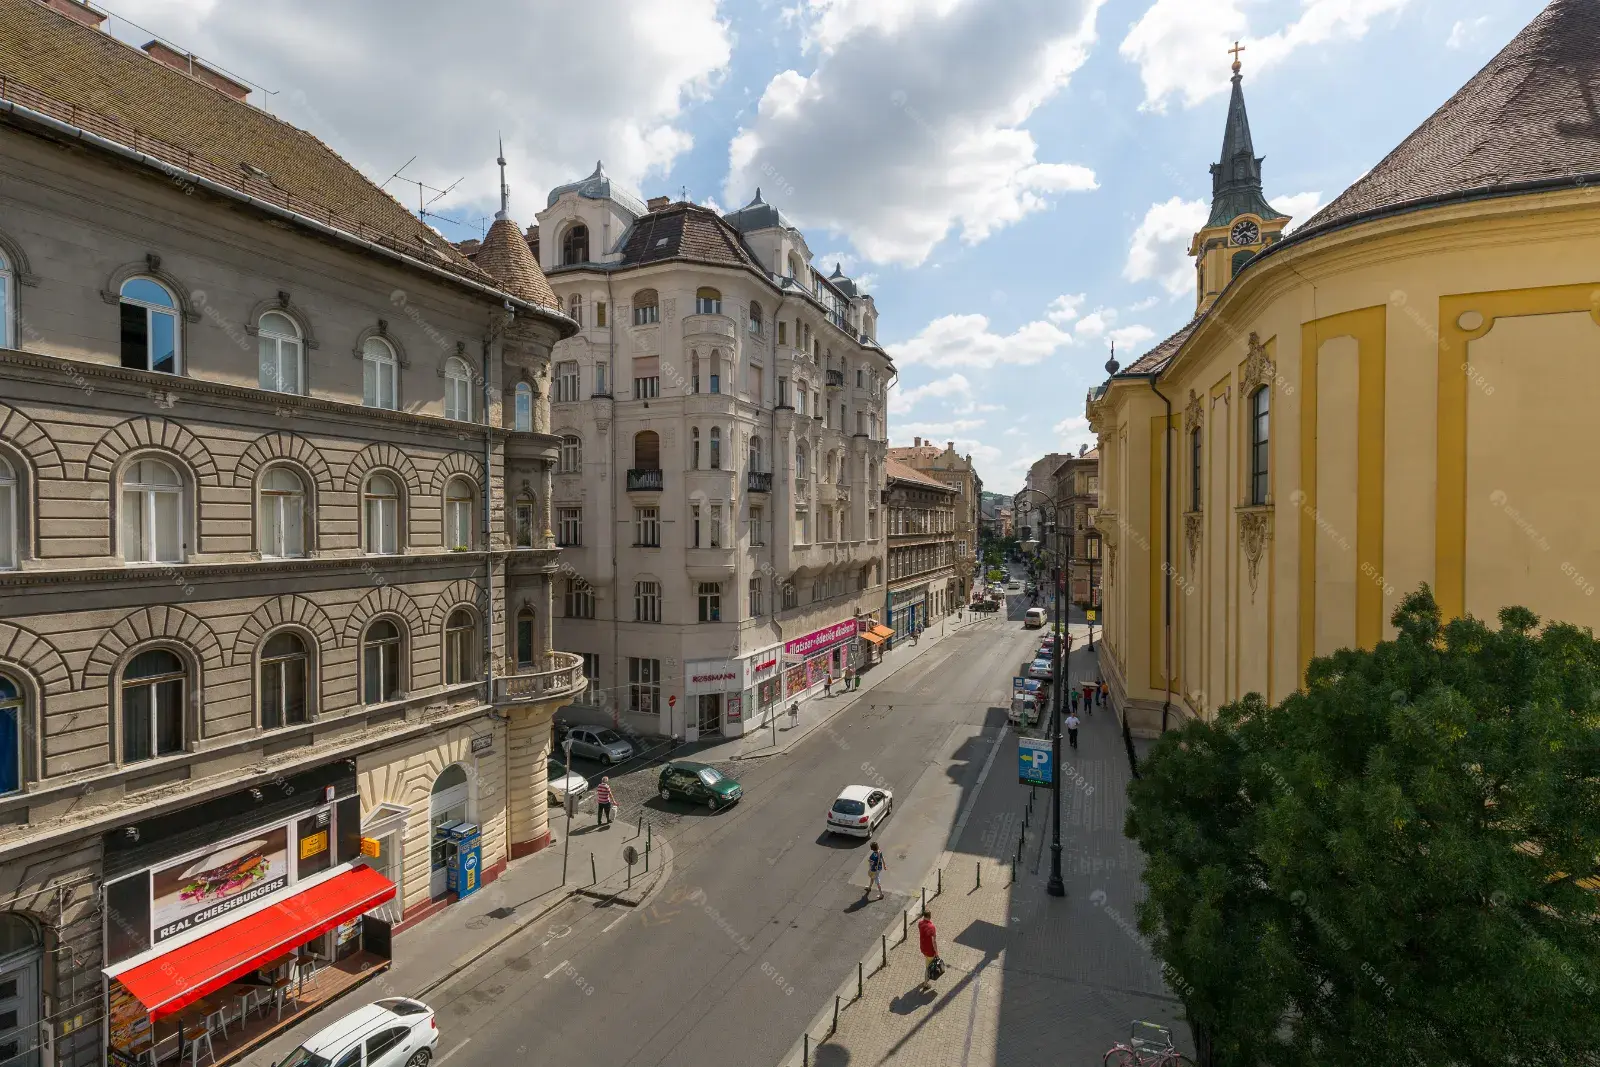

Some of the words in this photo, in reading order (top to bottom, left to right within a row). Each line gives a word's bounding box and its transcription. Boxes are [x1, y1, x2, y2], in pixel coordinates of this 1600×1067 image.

[692, 672, 736, 683] ROSSMANN
[1032, 749, 1049, 769] P
[160, 919, 192, 939] REAL
[194, 878, 284, 923] CHEESEBURGERS
